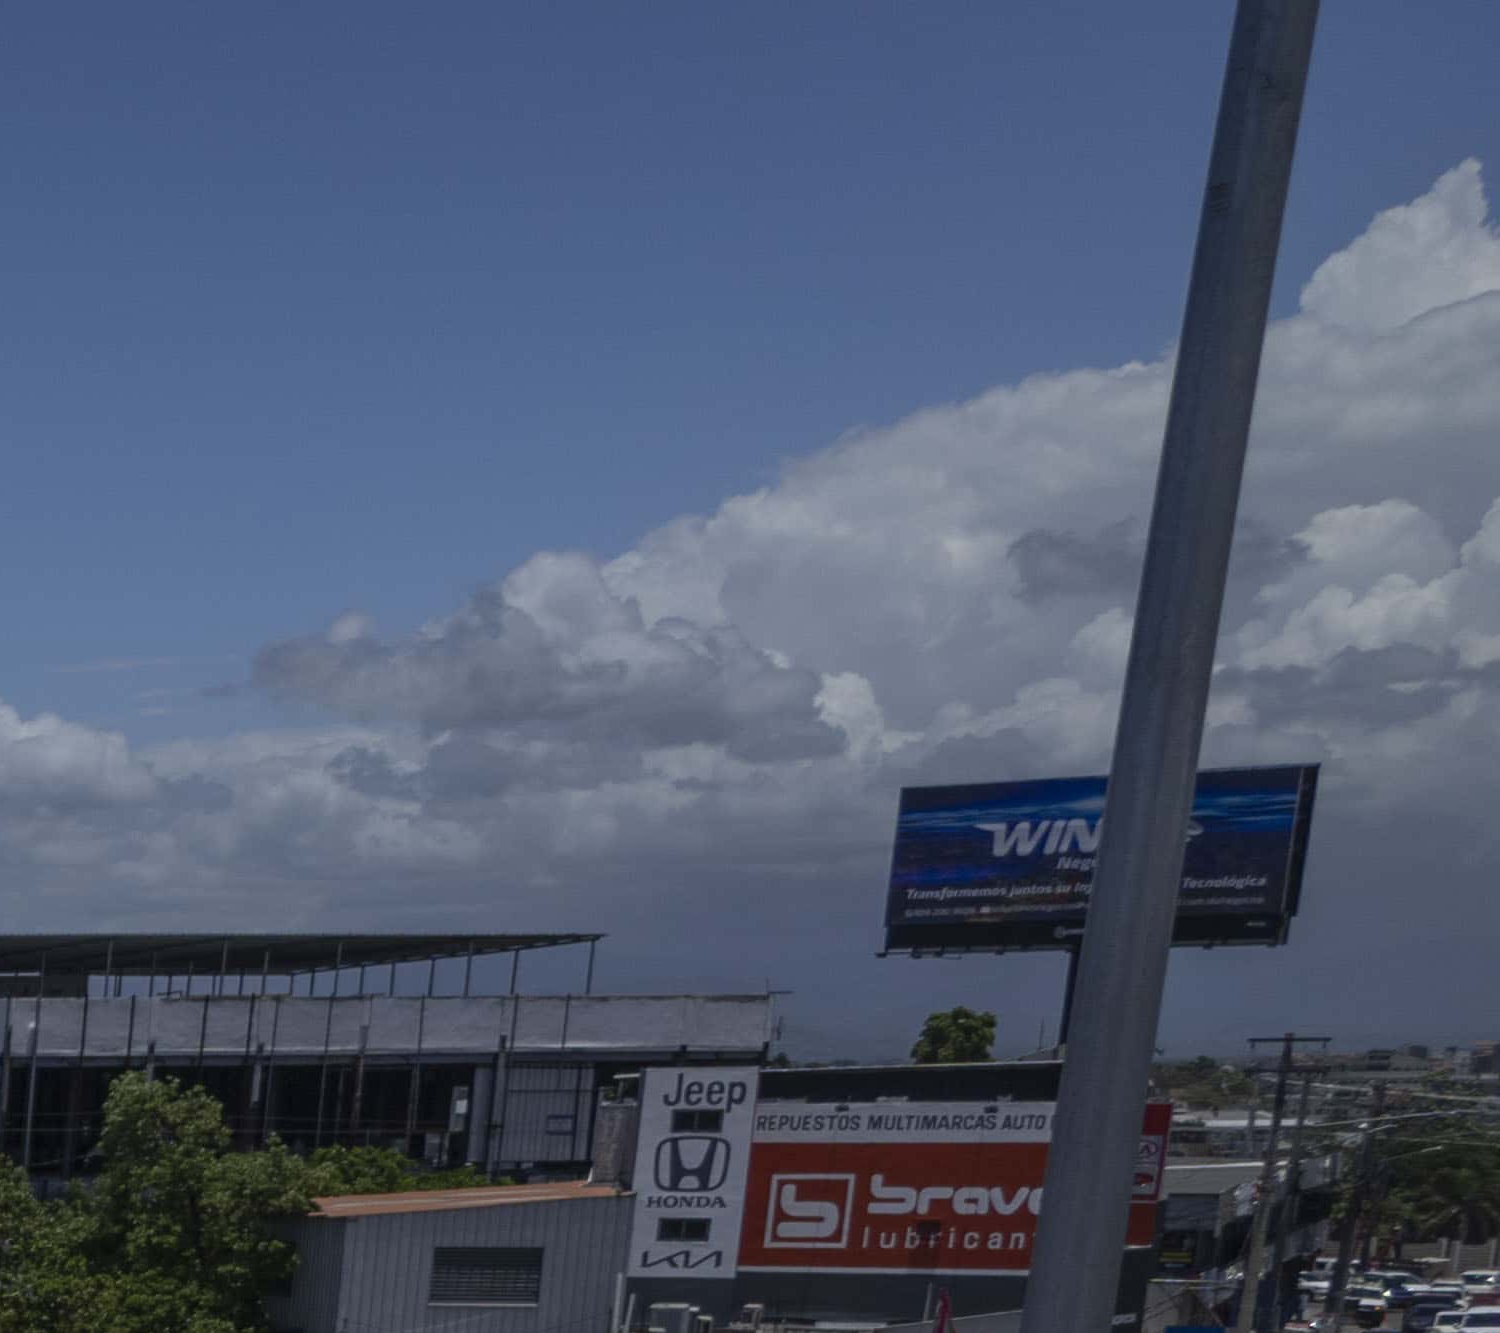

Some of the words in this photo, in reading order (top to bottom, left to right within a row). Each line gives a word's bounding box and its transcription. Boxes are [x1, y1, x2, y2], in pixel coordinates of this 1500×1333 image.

[906, 887, 1007, 901] Transformemos
[1008, 885, 1051, 898] juntos
[663, 1074, 747, 1112] Jeep
[756, 1114, 861, 1132] REPUESTOS
[866, 1113, 998, 1131] MULTIMARCAS
[1001, 1113, 1048, 1131] AUTO
[645, 1195, 728, 1208] HONDA
[861, 1225, 1037, 1250] lubrican
